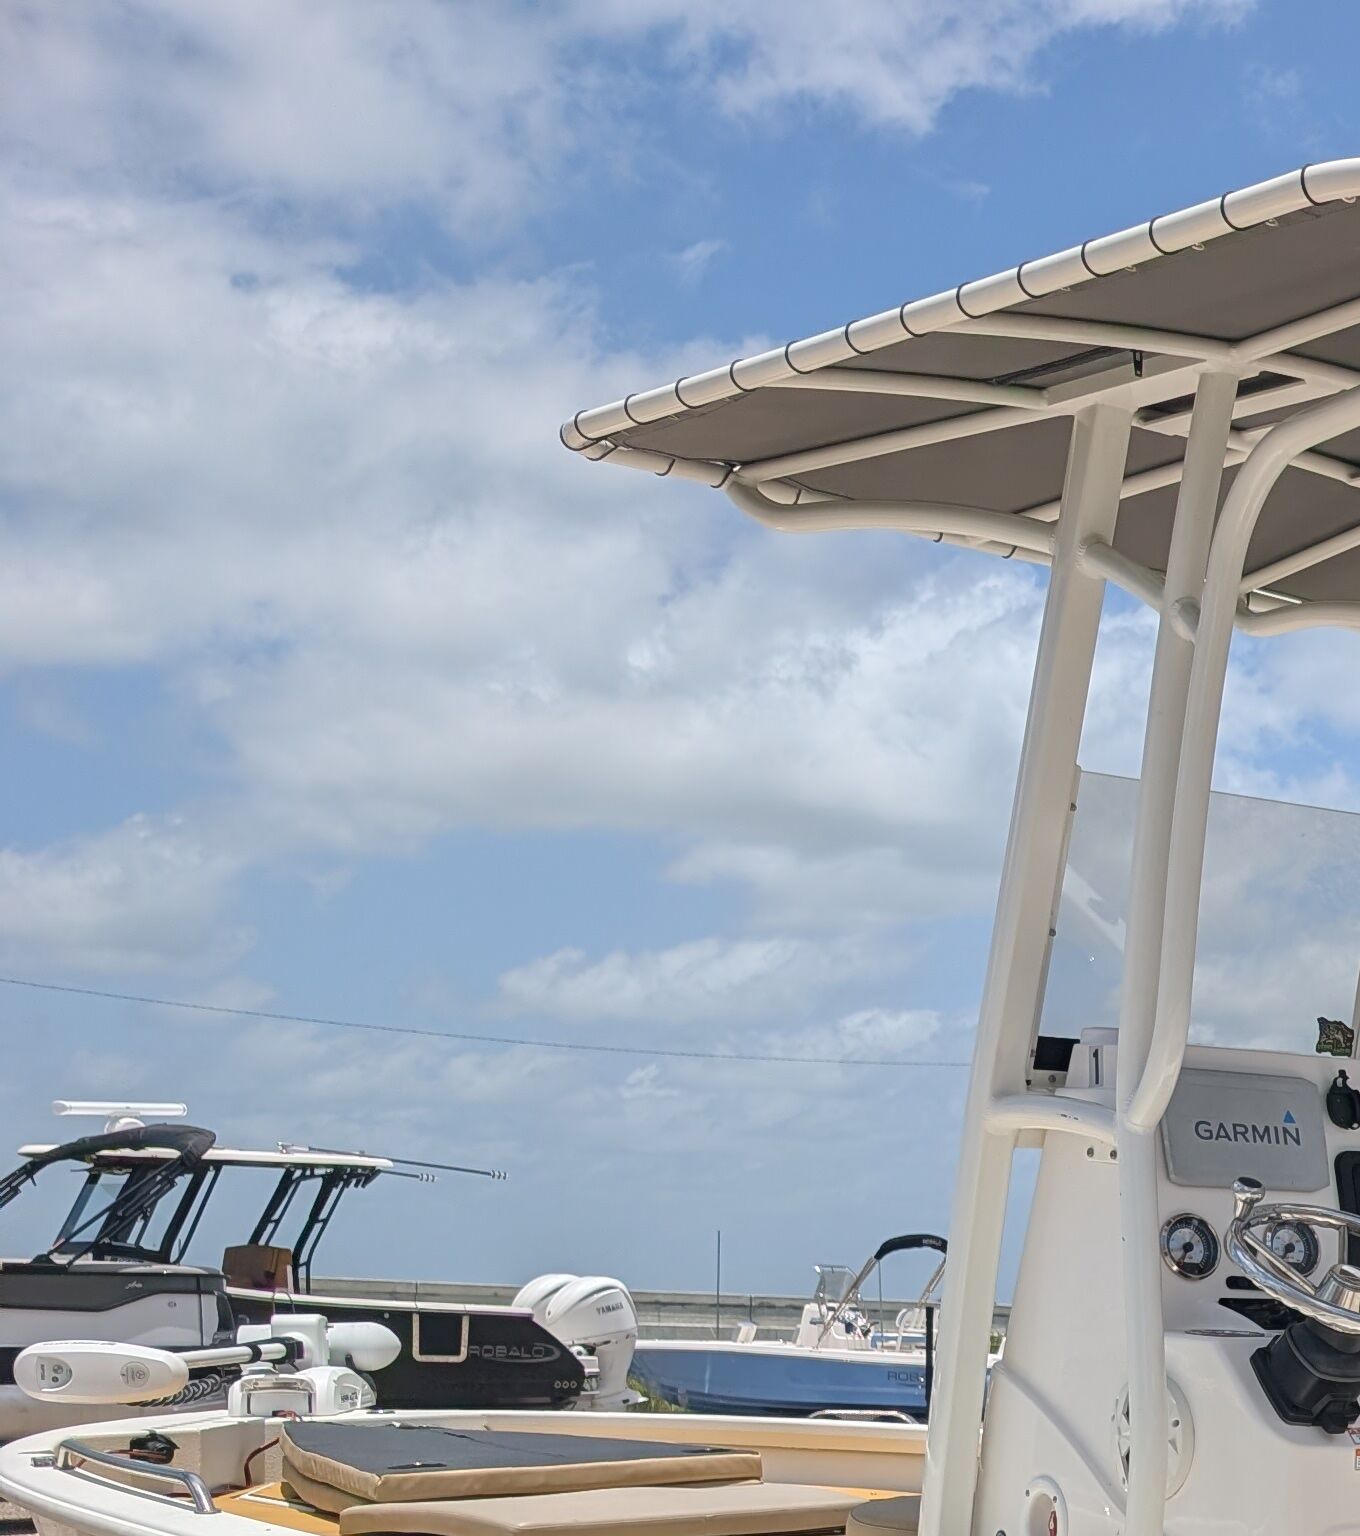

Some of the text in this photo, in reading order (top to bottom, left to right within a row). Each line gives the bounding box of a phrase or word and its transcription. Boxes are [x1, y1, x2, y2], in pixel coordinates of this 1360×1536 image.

[1194, 1120, 1301, 1146] GARMIN
[469, 1344, 545, 1358] ROBALO
[888, 1370, 925, 1382] ROB
